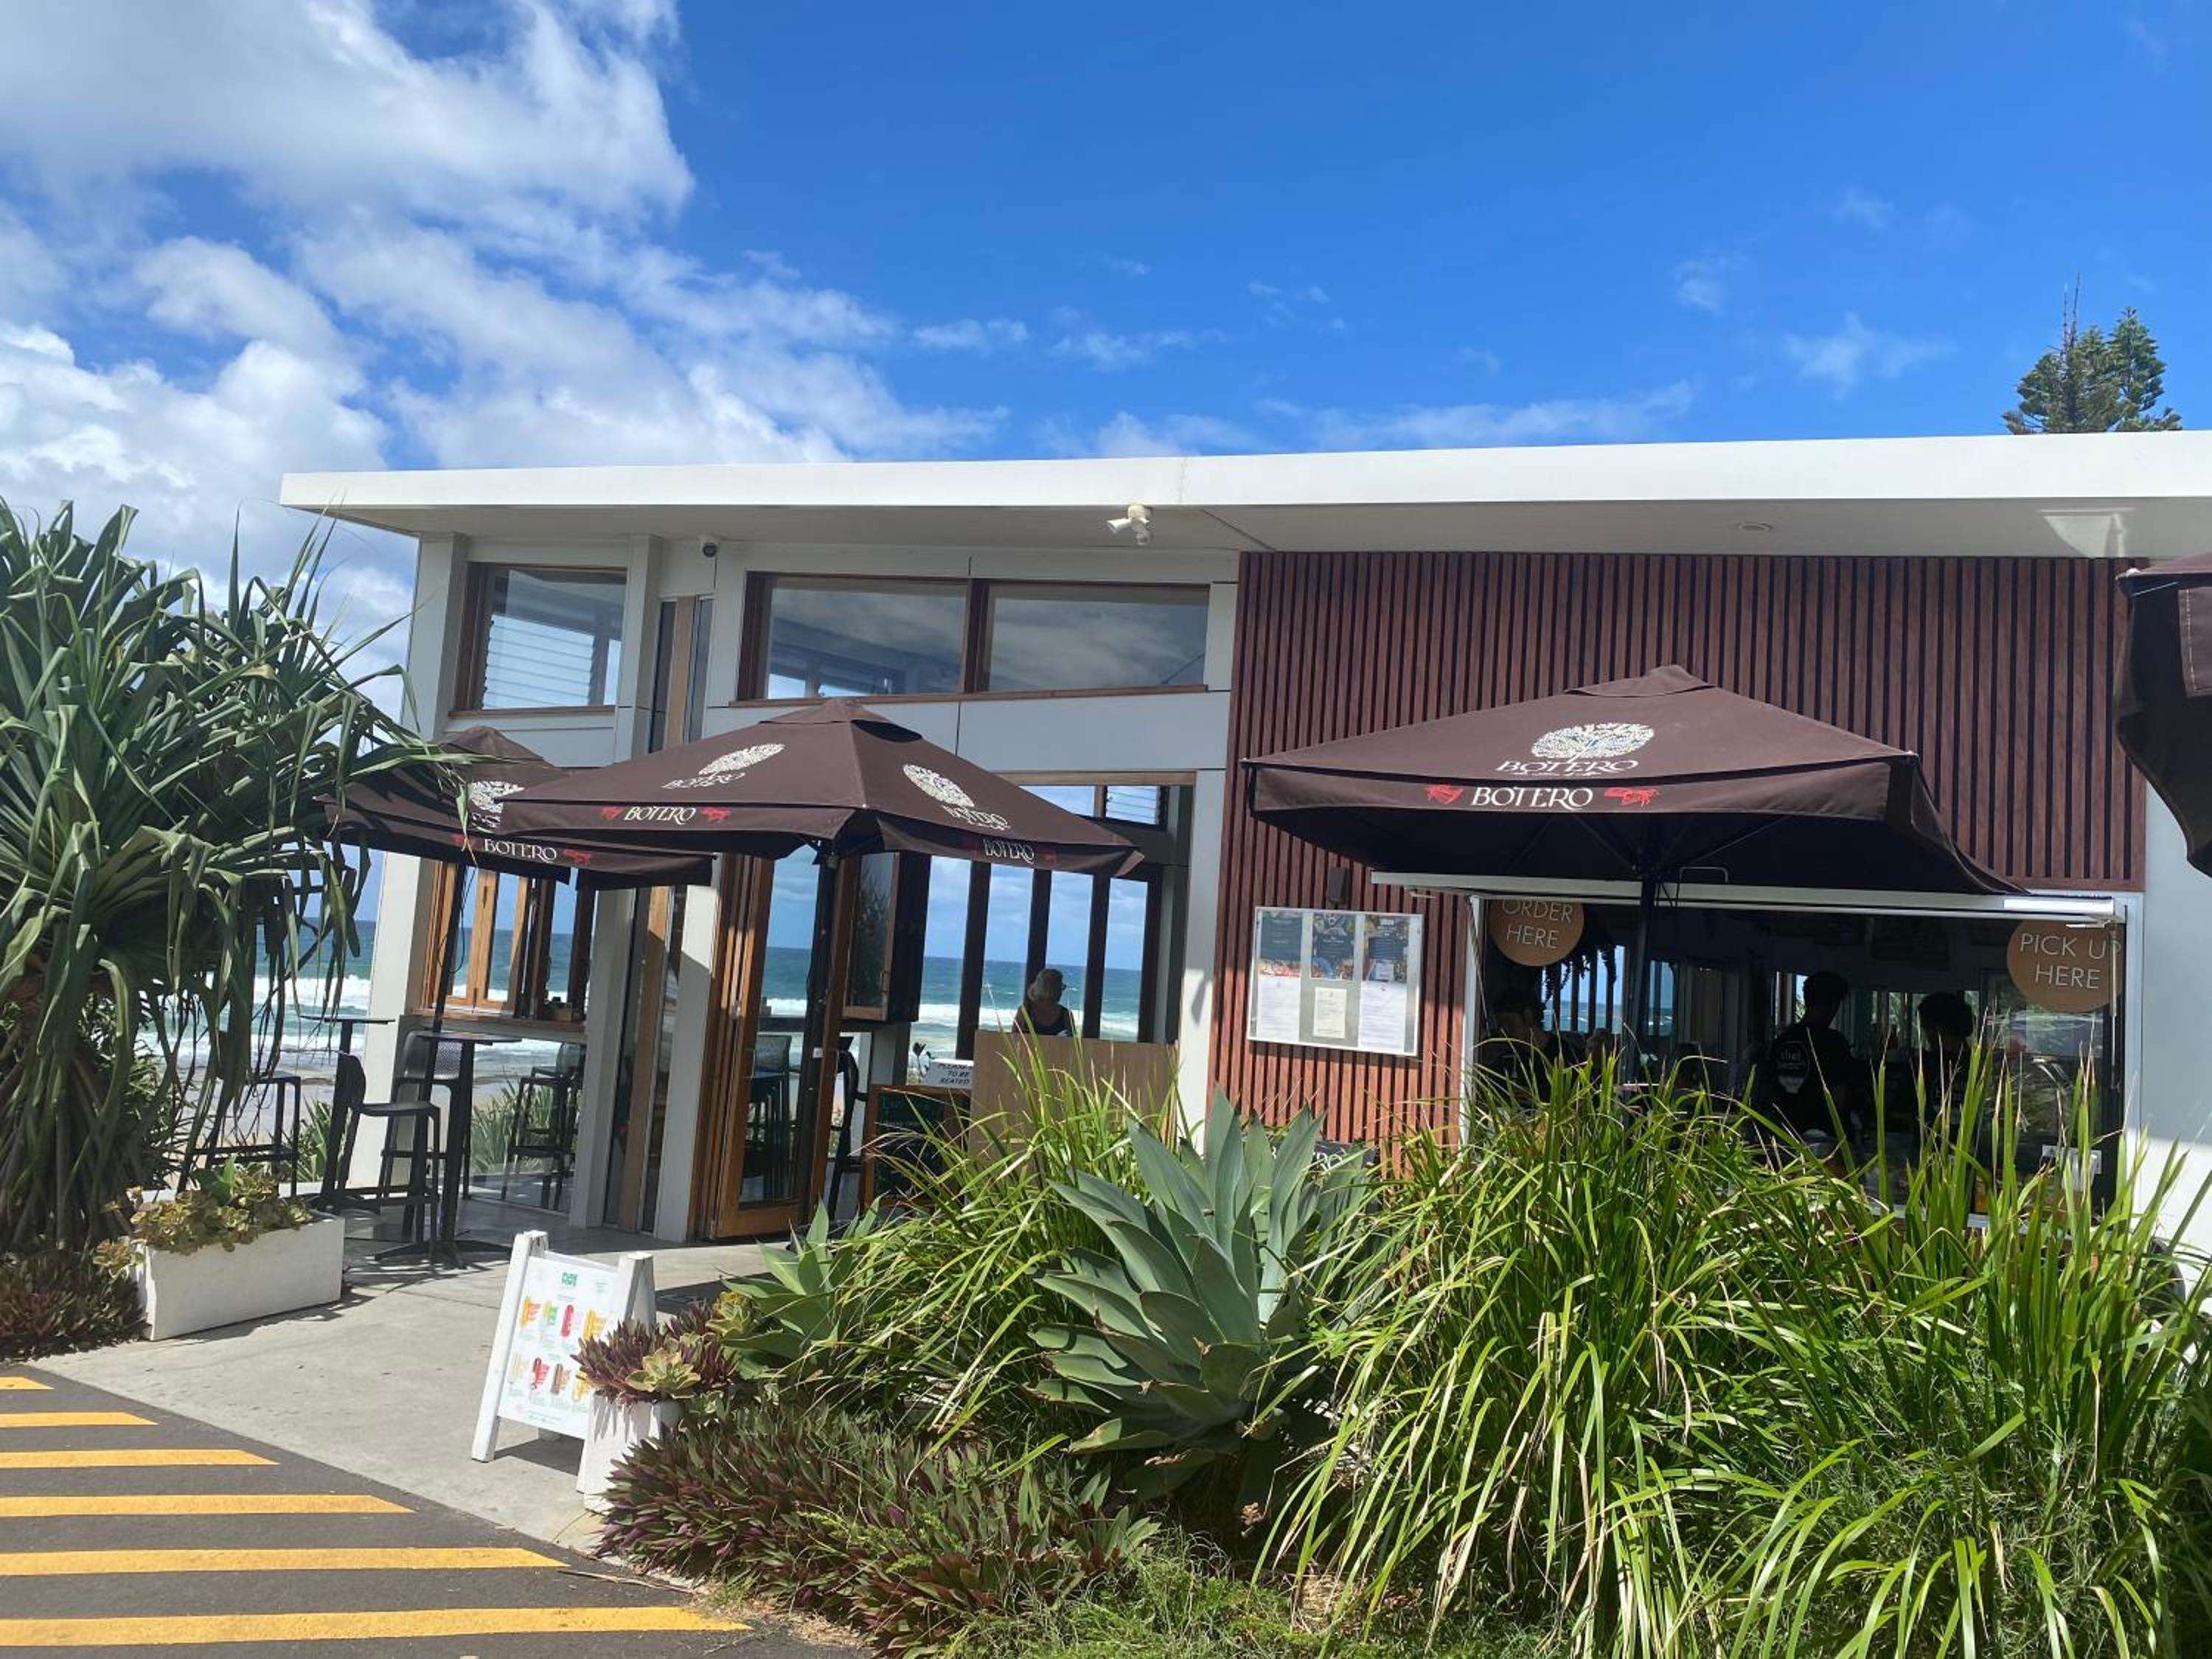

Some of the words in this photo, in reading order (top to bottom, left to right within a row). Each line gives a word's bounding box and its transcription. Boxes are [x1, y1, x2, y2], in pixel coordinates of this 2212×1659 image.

[1495, 759, 1638, 773] BOTERO
[1472, 786, 1593, 810] BOTERO
[622, 805, 697, 822] BOTERO
[484, 838, 557, 863] BOTERO
[983, 838, 1034, 865] BOTERO
[1502, 900, 1573, 923] ORDER
[1506, 924, 1559, 950] HERE
[2020, 933, 2077, 957] PICK
[2035, 963, 2101, 990] HERE
